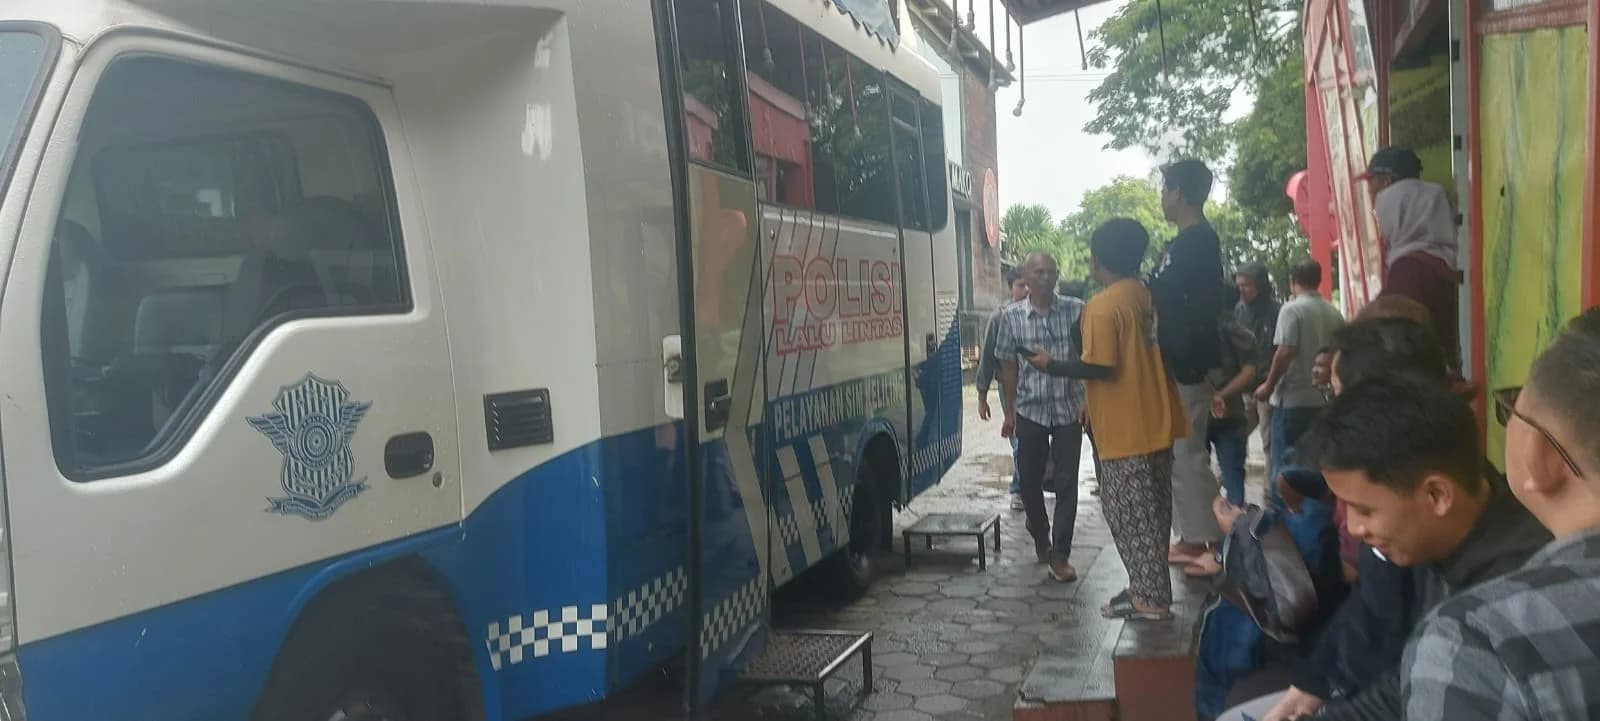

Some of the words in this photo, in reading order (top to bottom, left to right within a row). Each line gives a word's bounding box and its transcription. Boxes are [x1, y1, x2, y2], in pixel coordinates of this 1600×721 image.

[773, 255, 902, 324] POLISI
[776, 322, 835, 356] LALU
[841, 318, 903, 345] LINTAS
[774, 389, 844, 442] PELAYANAN
[846, 383, 865, 417] SIM
